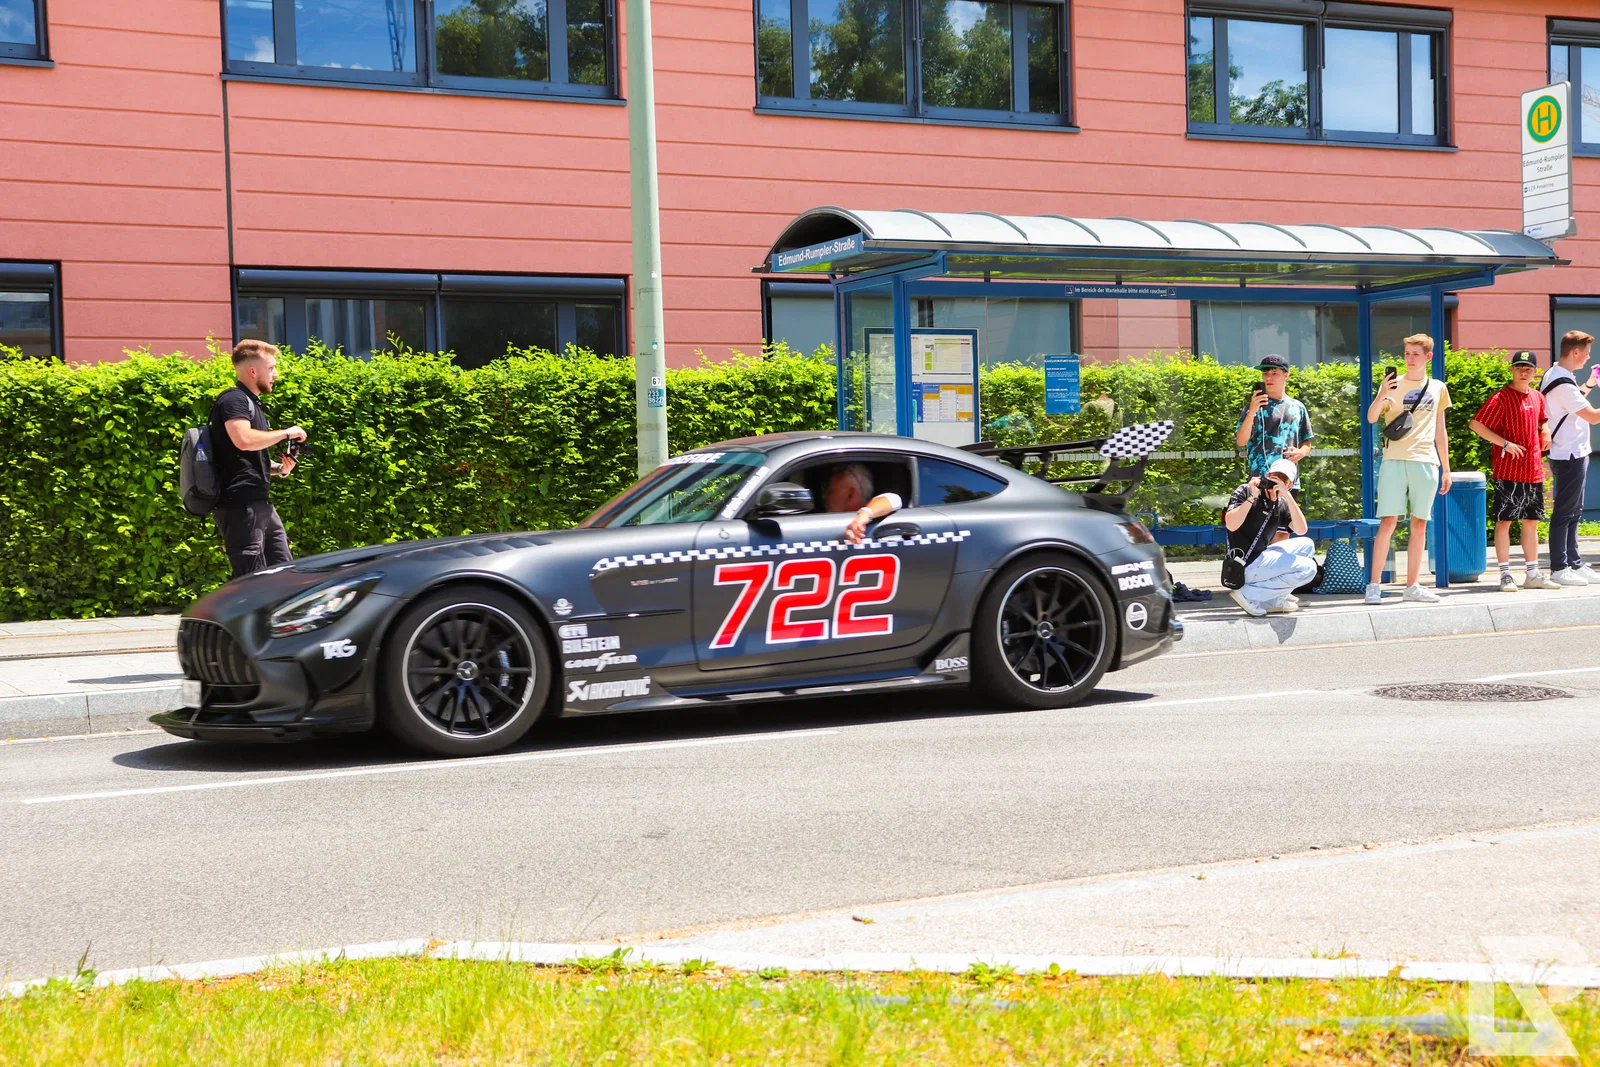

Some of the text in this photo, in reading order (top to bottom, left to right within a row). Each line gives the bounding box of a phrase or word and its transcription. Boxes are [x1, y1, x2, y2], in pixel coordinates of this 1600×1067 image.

[1537, 105, 1551, 133] H
[1523, 154, 1566, 167] Edmund-Rumpler-
[1537, 165, 1553, 173] Straße
[778, 239, 855, 266] Edmund-Rumpler-Straße
[1118, 574, 1154, 590] BOSCH
[708, 553, 901, 650] 722
[935, 656, 968, 670] BOSS
